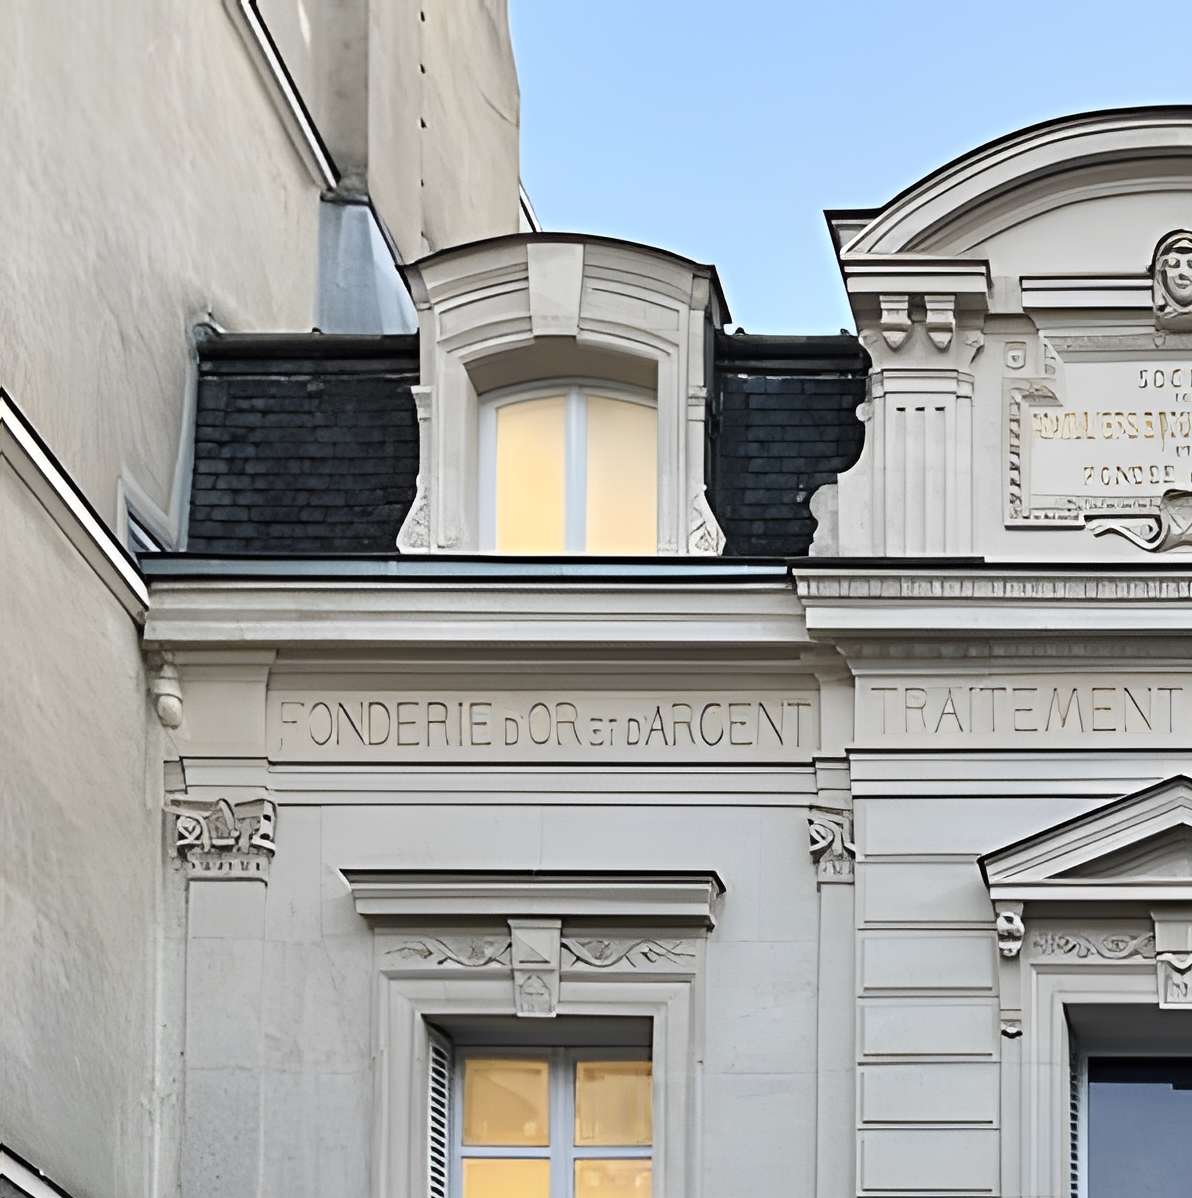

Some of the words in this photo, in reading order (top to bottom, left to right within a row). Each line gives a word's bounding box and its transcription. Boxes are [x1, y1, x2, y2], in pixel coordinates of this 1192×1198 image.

[281, 701, 492, 747] FONDERIE
[504, 702, 582, 746] D'OR
[871, 685, 1183, 734] TRAITEMENT
